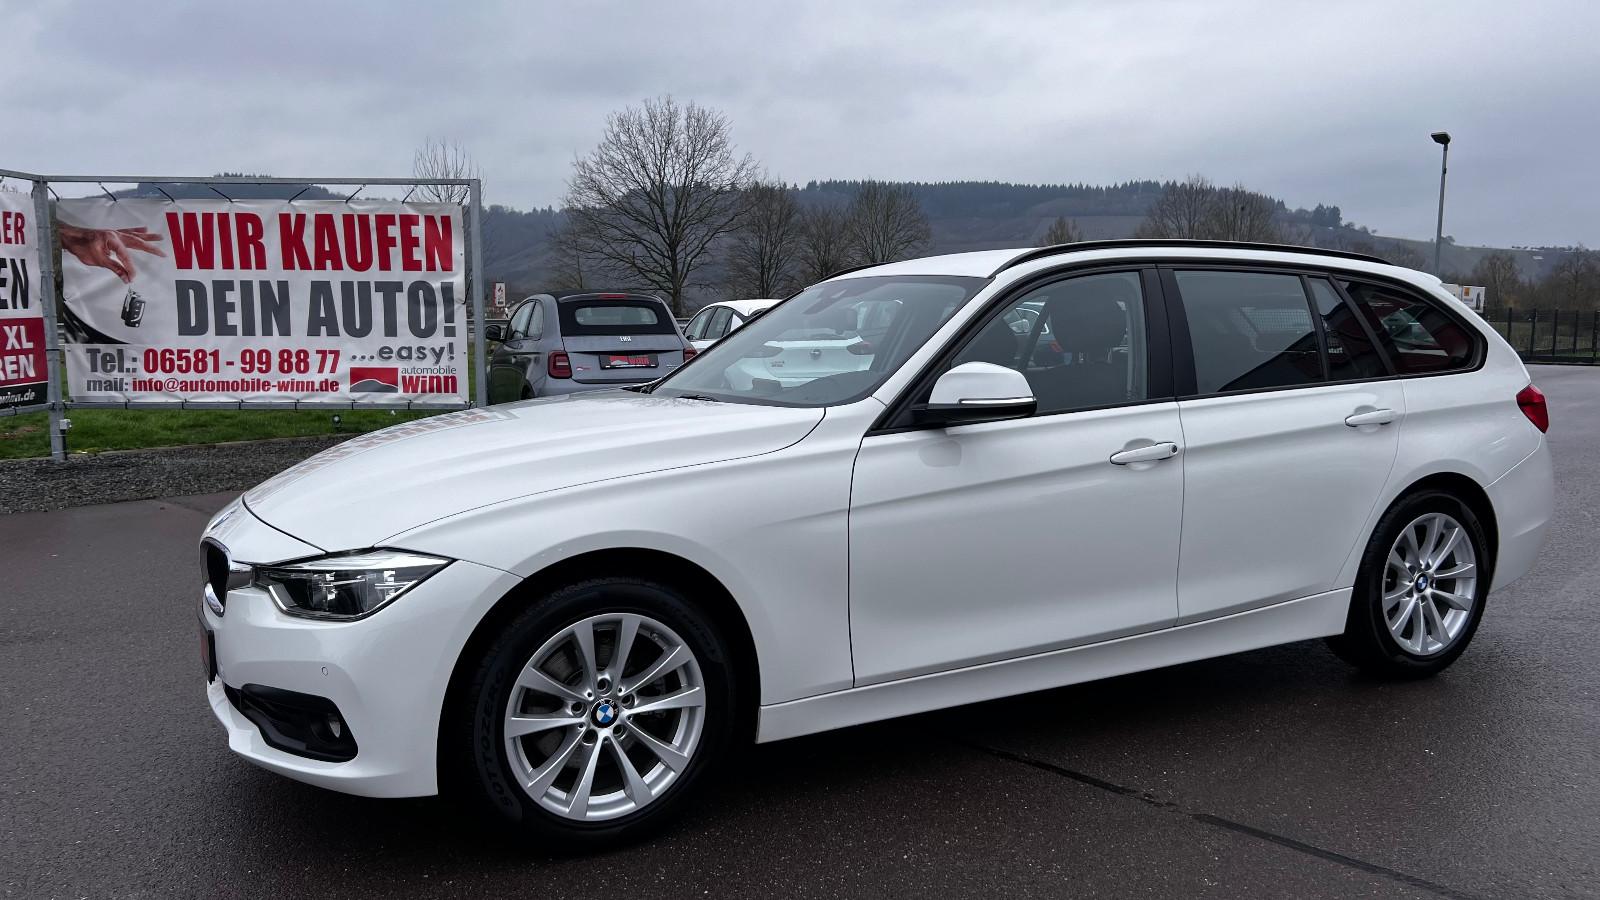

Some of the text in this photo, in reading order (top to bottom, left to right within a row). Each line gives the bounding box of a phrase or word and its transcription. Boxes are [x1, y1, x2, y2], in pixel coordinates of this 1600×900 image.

[0, 211, 26, 244] ER
[165, 212, 453, 272] WIR KAUFEN
[175, 280, 456, 338] DEIN AUTO!
[3, 326, 34, 350] XL
[86, 348, 137, 373] Tel.:
[143, 348, 220, 374] 06581
[240, 349, 272, 374] 99
[278, 349, 310, 374] 88
[315, 350, 340, 374] 77
[351, 342, 455, 364] ...easy!
[401, 366, 457, 374] automobile
[86, 378, 340, 393] mail: info@automobile-winn.de
[401, 375, 458, 393] winn
